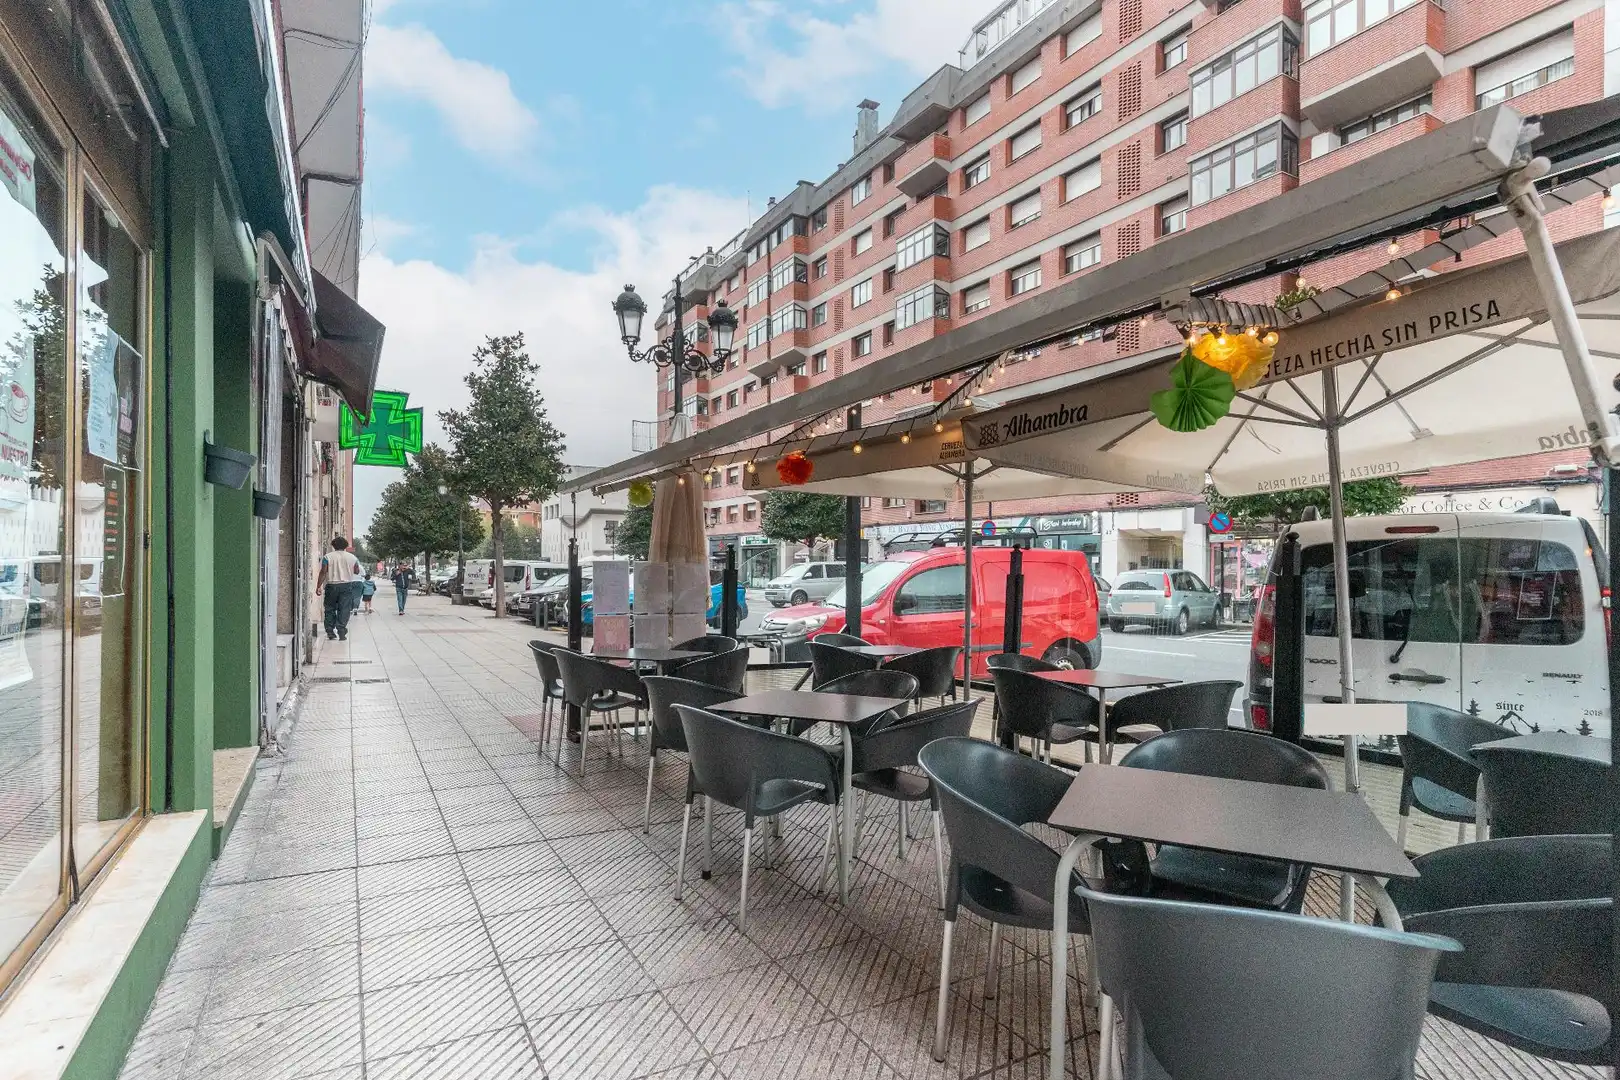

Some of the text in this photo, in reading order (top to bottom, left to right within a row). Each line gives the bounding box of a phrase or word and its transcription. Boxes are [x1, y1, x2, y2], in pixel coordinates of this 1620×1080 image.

[1264, 299, 1501, 379] VEZA HECHA SIN PRISA
[1002, 403, 1088, 441] Alhambra
[1421, 499, 1473, 513] Coffee
[1478, 497, 1492, 511] &
[1496, 701, 1525, 712] since
[1584, 709, 1603, 717] 2018
